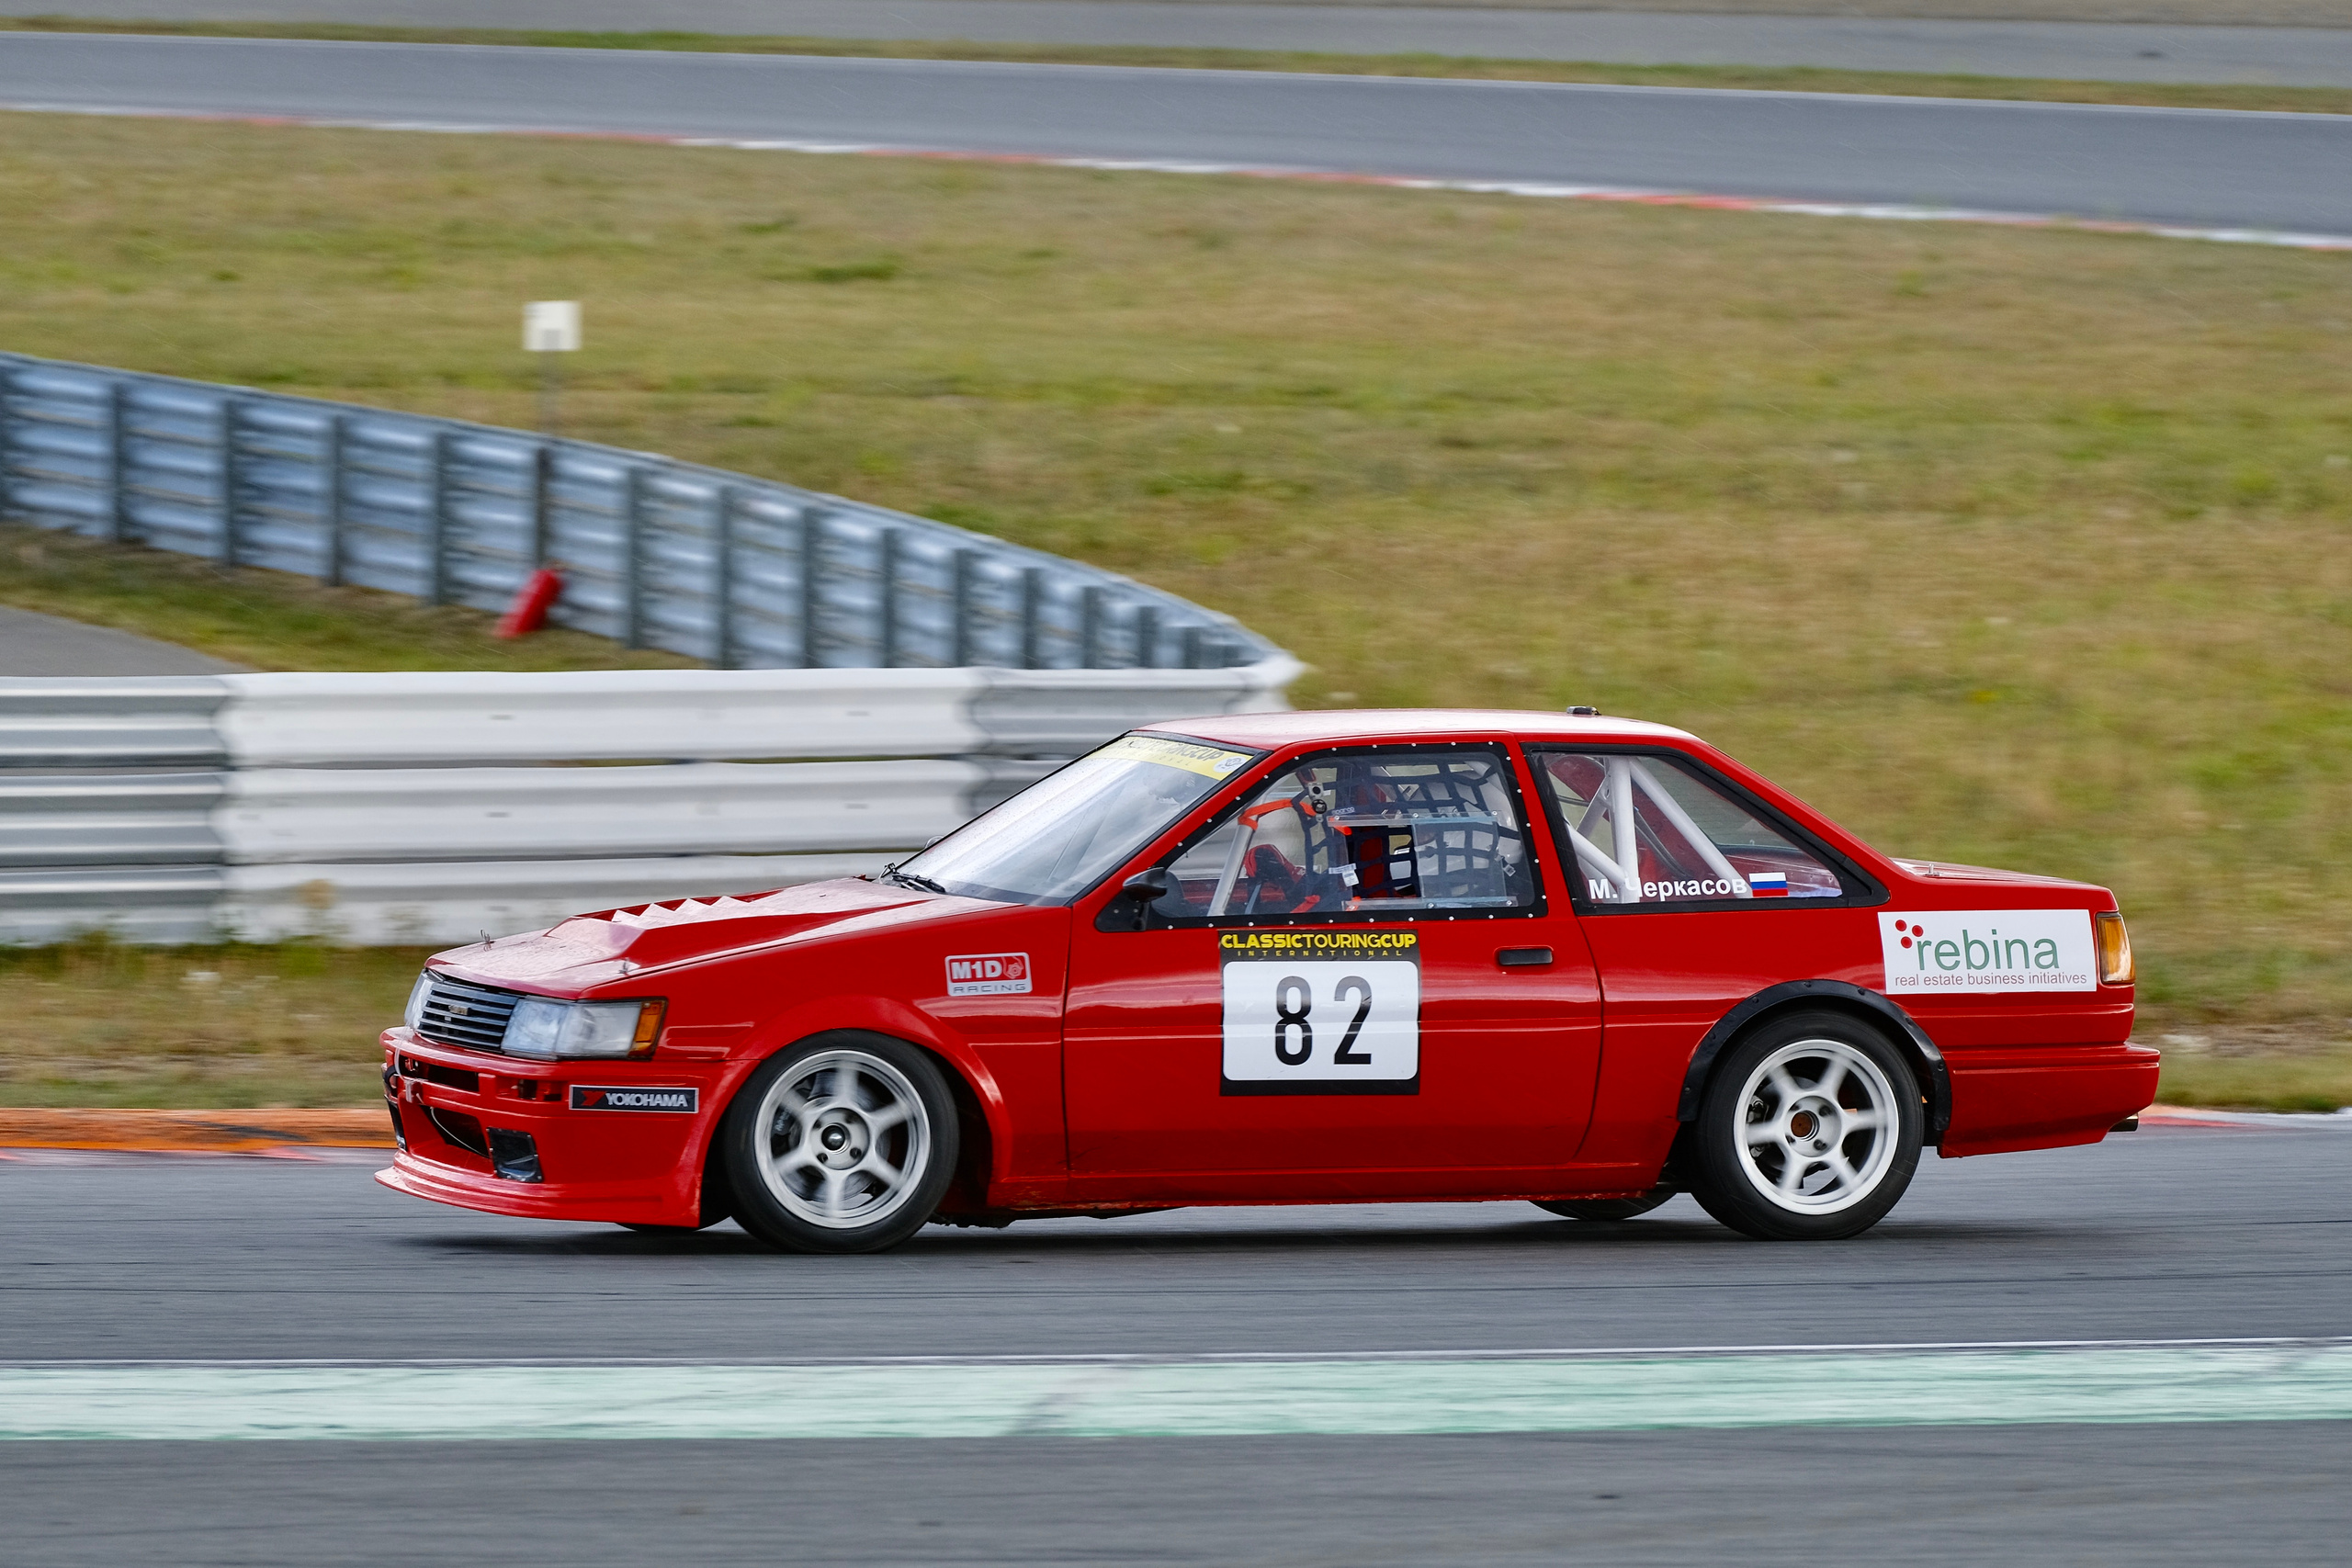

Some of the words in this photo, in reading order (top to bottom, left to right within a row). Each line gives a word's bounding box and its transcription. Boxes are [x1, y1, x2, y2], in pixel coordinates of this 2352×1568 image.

[1589, 879, 1618, 899] М.
[1624, 877, 1747, 902] Черкасов
[1221, 933, 1417, 948] CLASSICTOURINGCUP
[1917, 929, 2060, 971] rebina
[950, 960, 1002, 980] M1D
[1894, 974, 1919, 987] real
[1924, 974, 1963, 986] estate
[1968, 973, 2025, 986] business
[2029, 971, 2087, 985] initiatives
[953, 983, 1026, 994] RACING
[1275, 976, 1372, 1066] 82
[605, 1092, 688, 1108] YOKOHAMA
